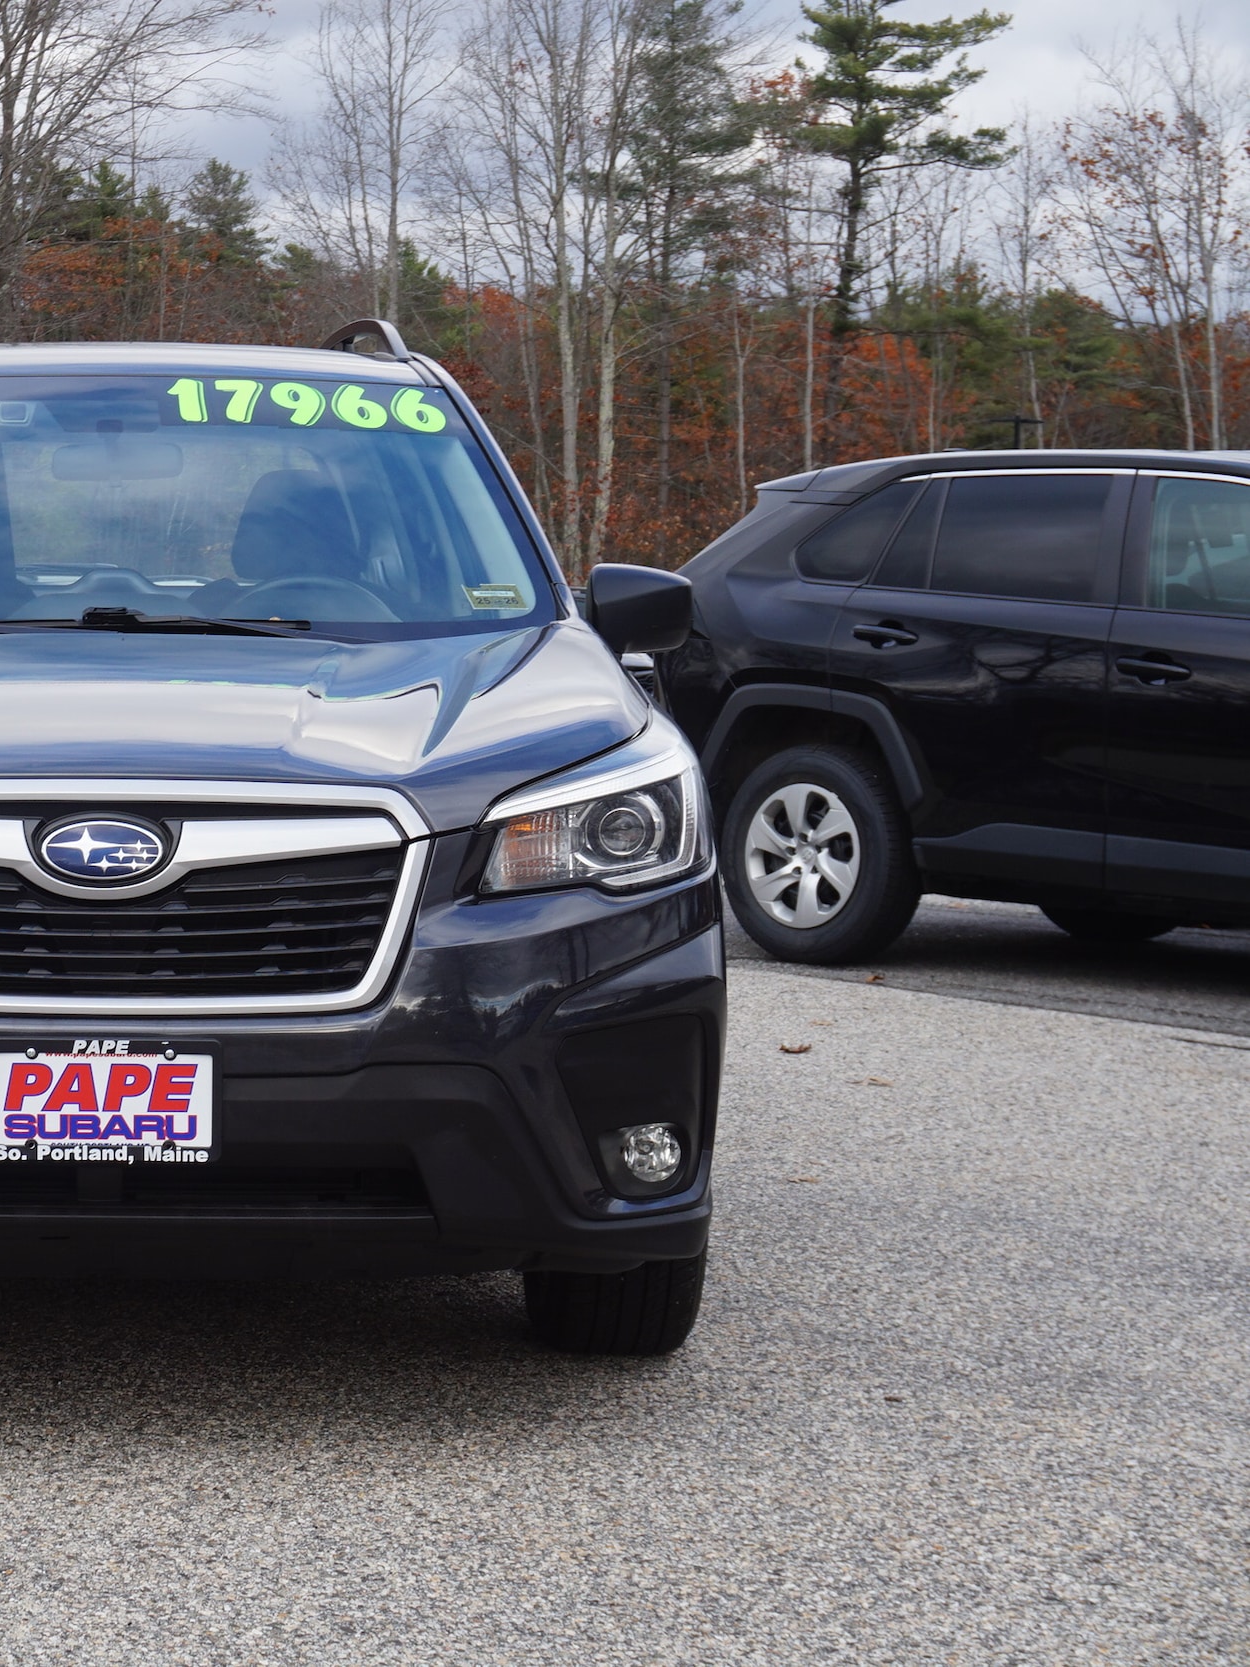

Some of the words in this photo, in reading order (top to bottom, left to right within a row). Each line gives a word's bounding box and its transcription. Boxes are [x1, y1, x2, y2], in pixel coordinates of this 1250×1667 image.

[166, 378, 447, 433] 17966
[72, 1039, 130, 1054] PAPE
[3, 1062, 199, 1113] PAPE
[3, 1113, 198, 1141] SUBARU
[36, 1144, 135, 1165] Portland,
[143, 1145, 209, 1162] Maine
